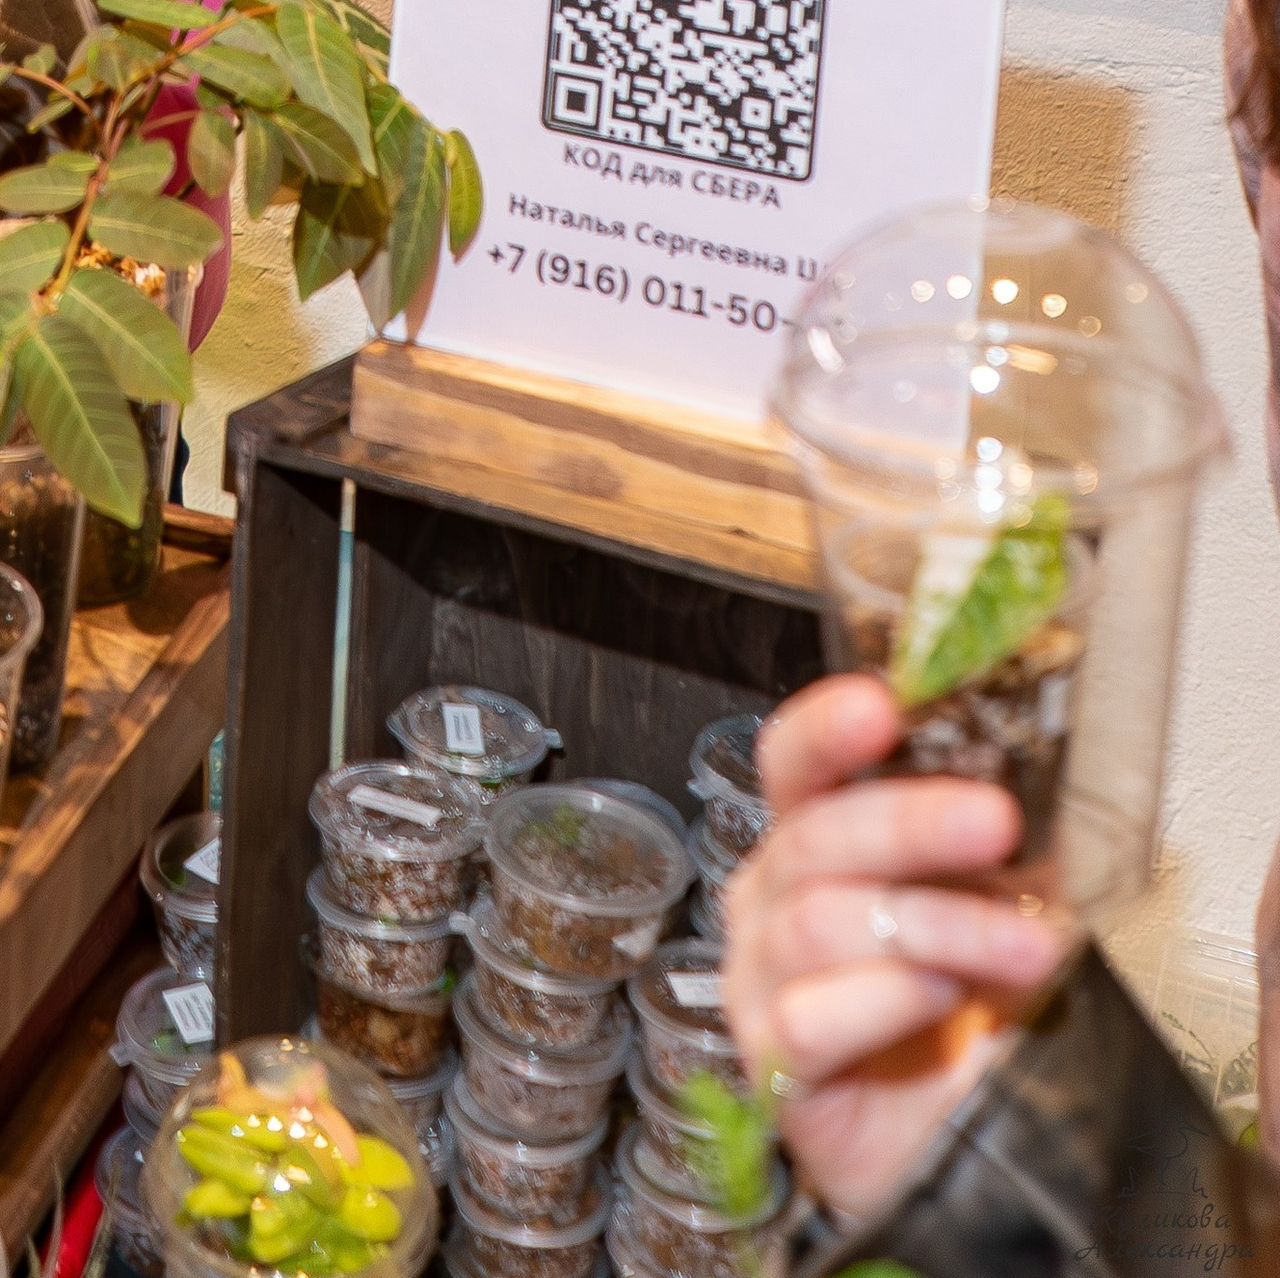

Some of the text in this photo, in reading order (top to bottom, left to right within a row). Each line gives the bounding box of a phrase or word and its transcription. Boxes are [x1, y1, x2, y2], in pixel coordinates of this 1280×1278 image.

[562, 141, 782, 210] КОД для СБЕРА
[507, 192, 627, 240] Наталья
[634, 220, 788, 276] Сергеевна
[487, 242, 799, 333] +7 (916) 011-50-
